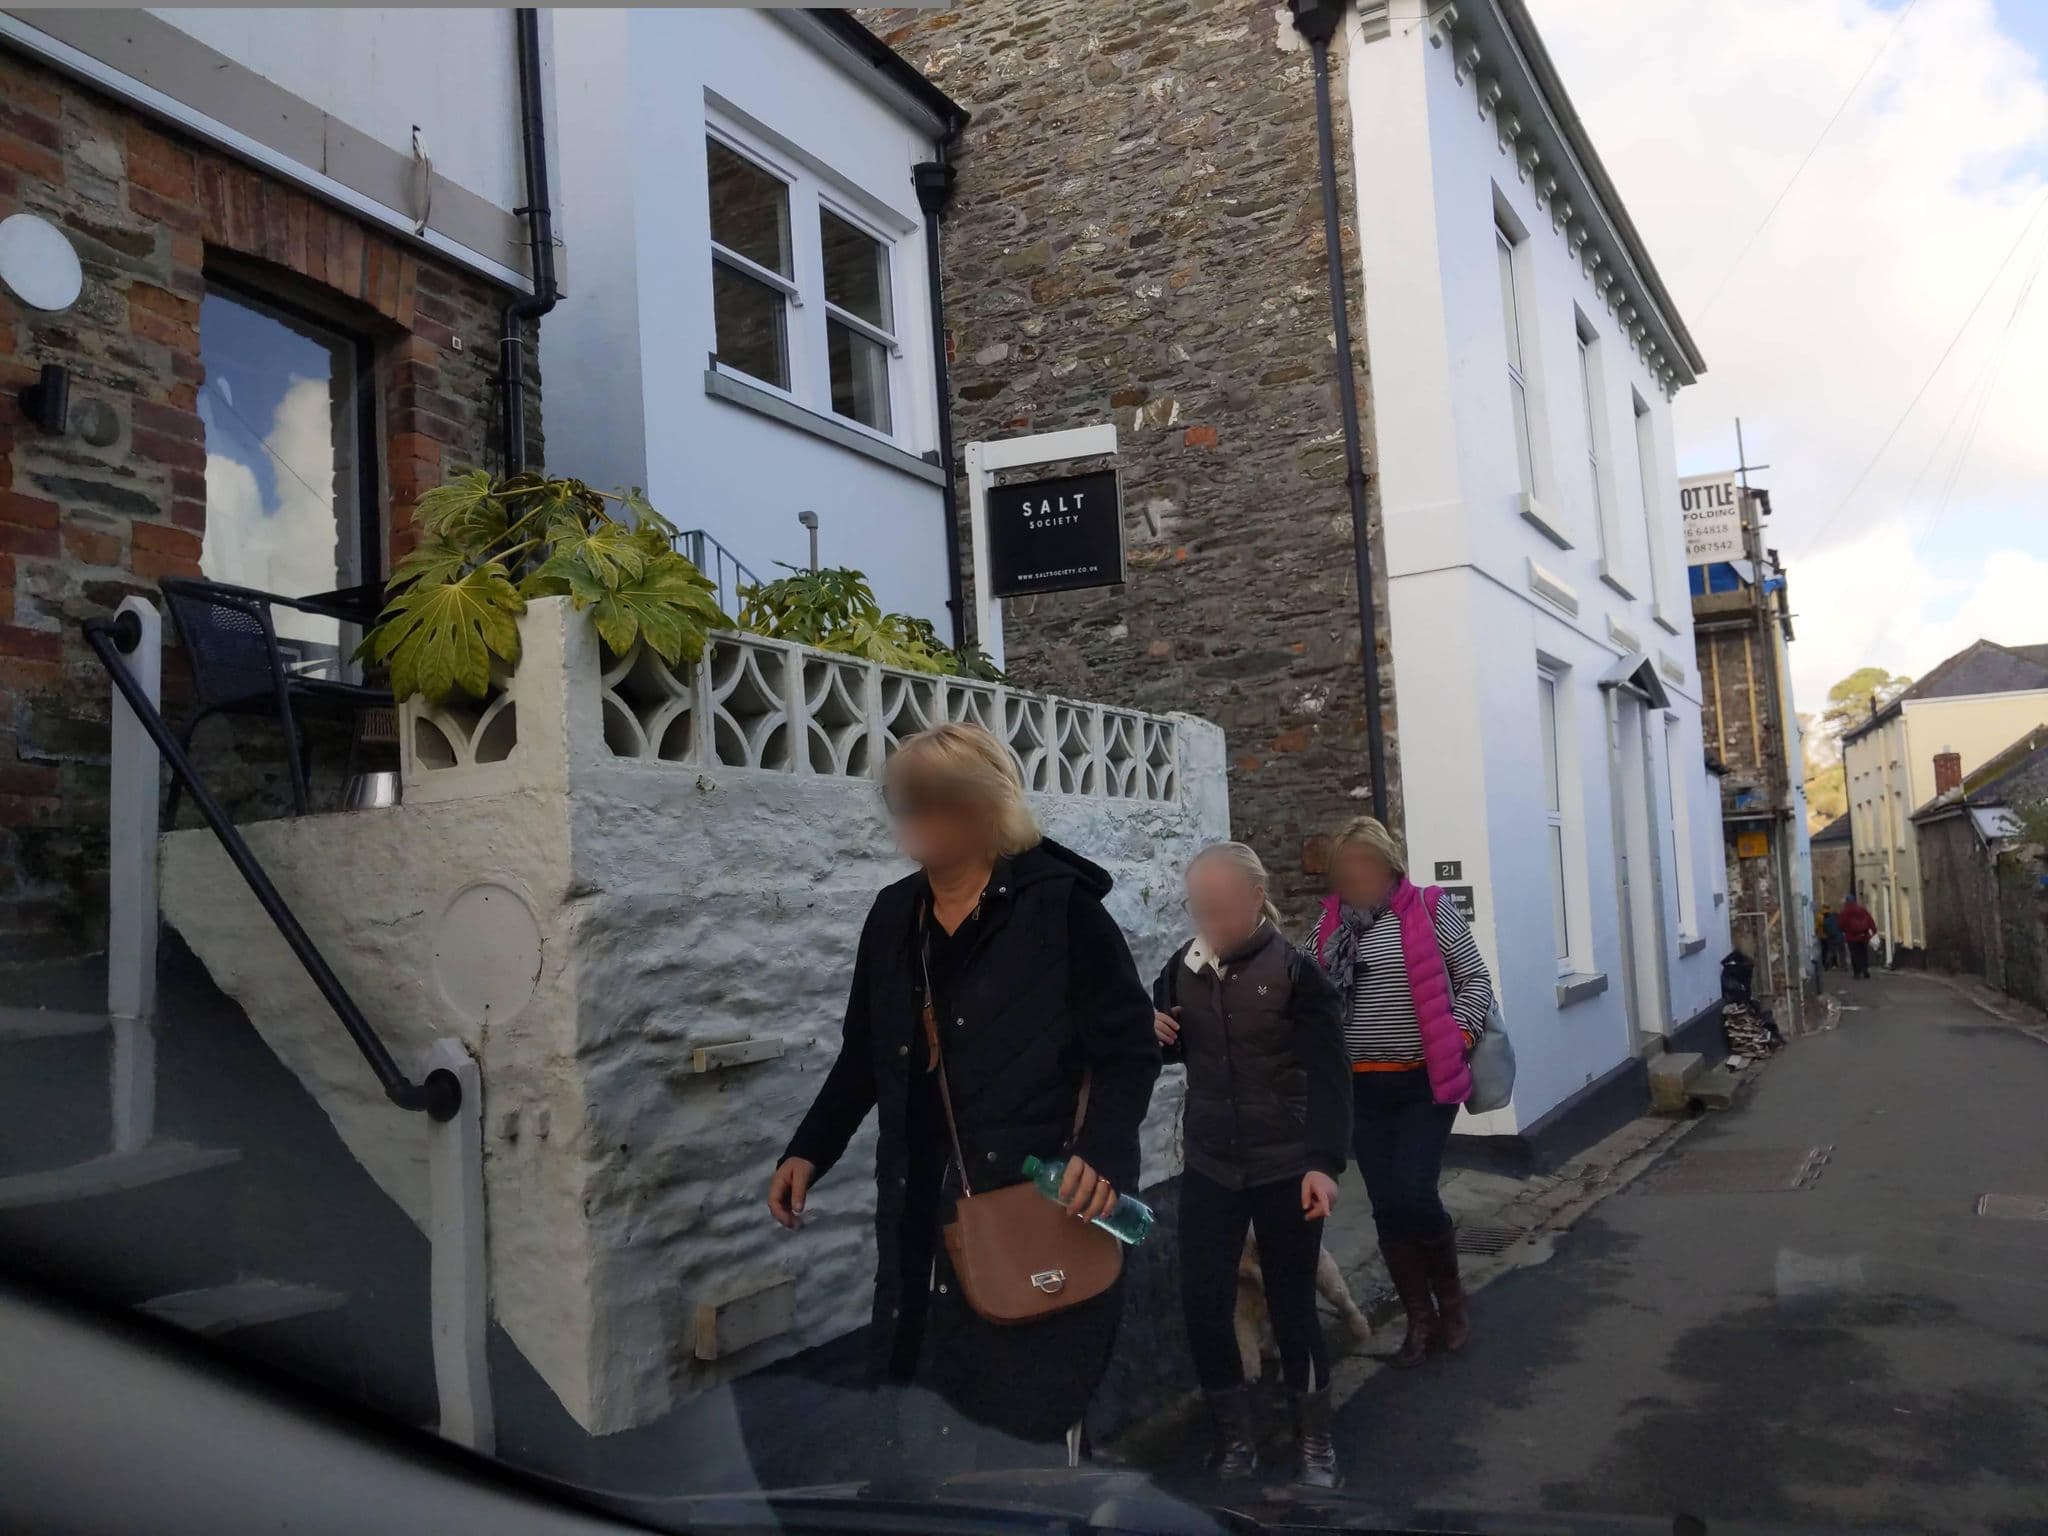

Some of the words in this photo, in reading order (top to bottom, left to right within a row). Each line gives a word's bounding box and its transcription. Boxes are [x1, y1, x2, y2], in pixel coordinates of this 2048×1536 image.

[1680, 483, 1734, 511] OTTLE
[1022, 493, 1084, 517] SALT
[1029, 515, 1079, 529] SOCIETY
[1017, 566, 1098, 581] WWW.SALTSOCIETY.CO.UK
[1442, 865, 1454, 877] 21
